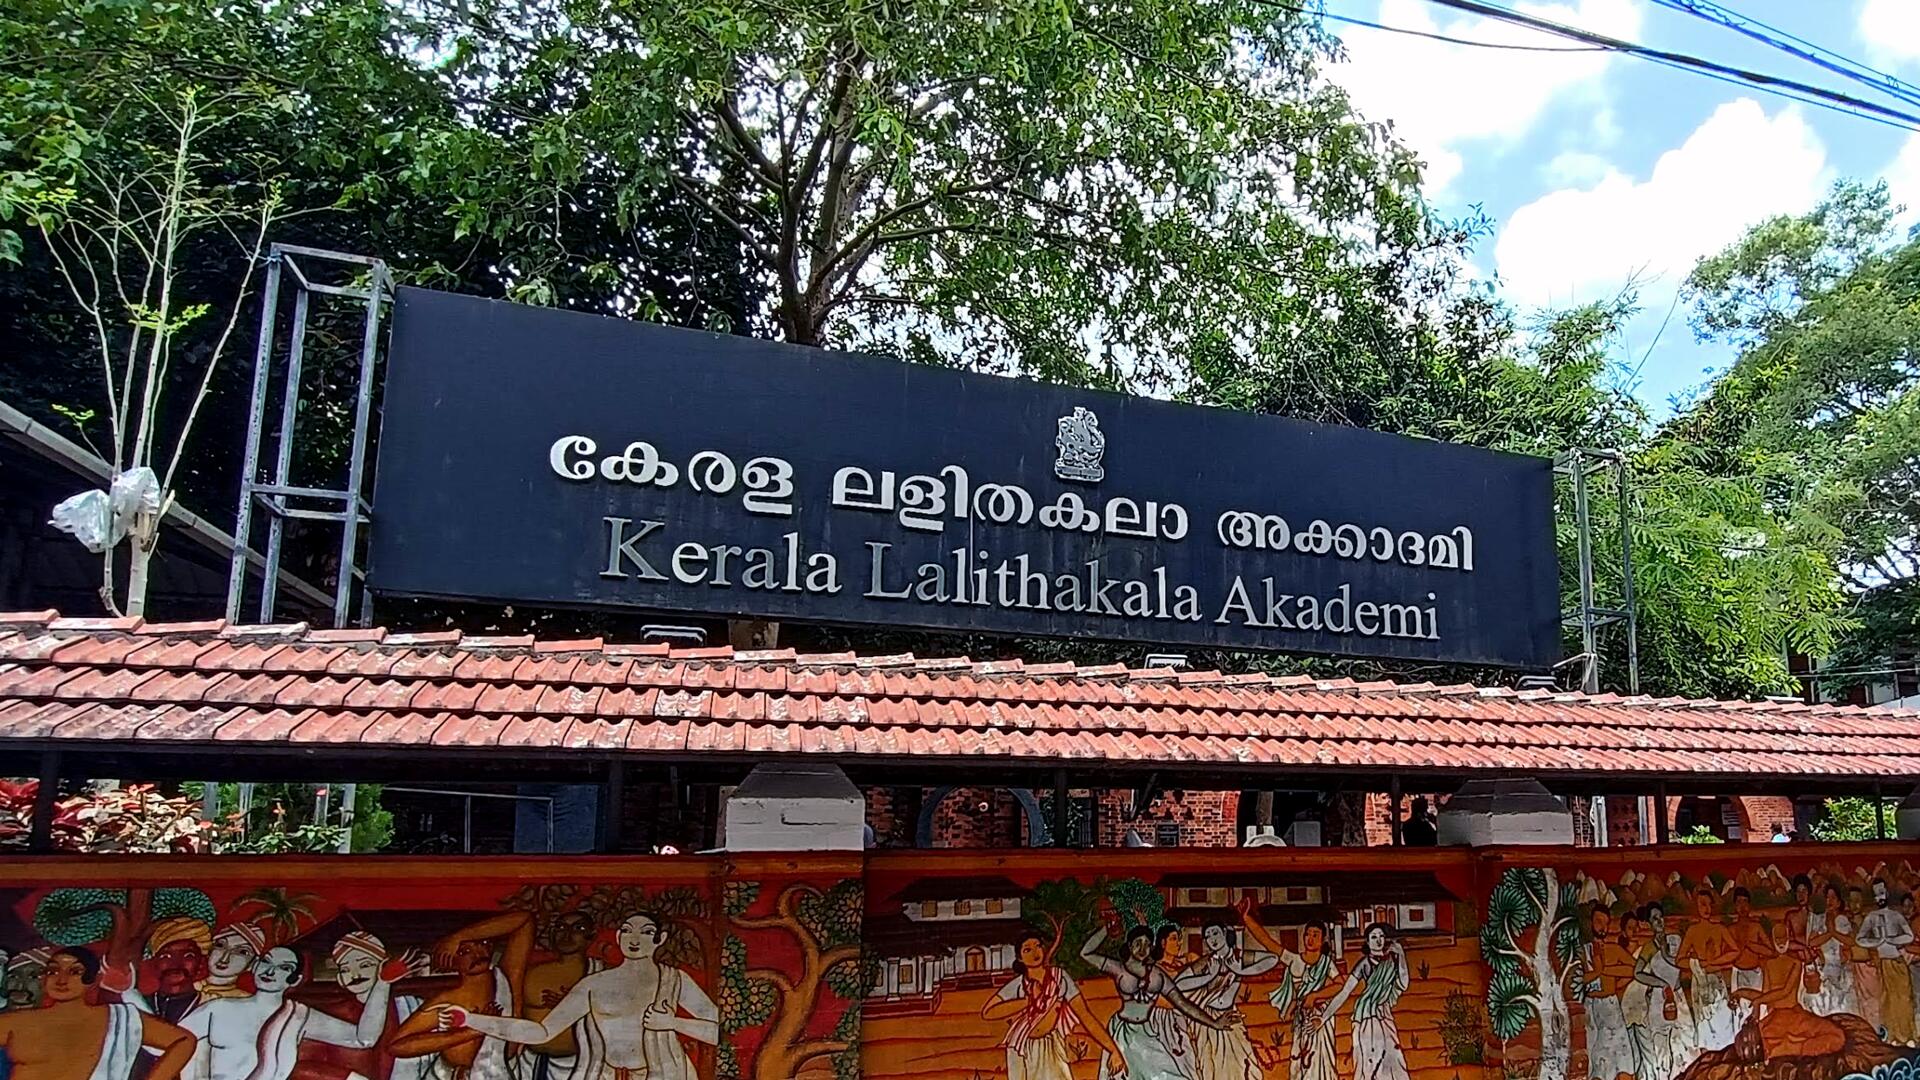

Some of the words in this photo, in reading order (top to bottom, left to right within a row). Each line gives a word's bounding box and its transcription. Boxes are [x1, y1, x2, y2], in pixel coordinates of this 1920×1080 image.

[550, 435, 793, 514] കേരള
[832, 465, 1188, 540] ലളിതകലാ
[1217, 510, 1474, 571] അക്കാദമി
[600, 517, 842, 593] Kerala
[863, 542, 1202, 621] Lalithakala
[1214, 575, 1441, 640] Akademi
